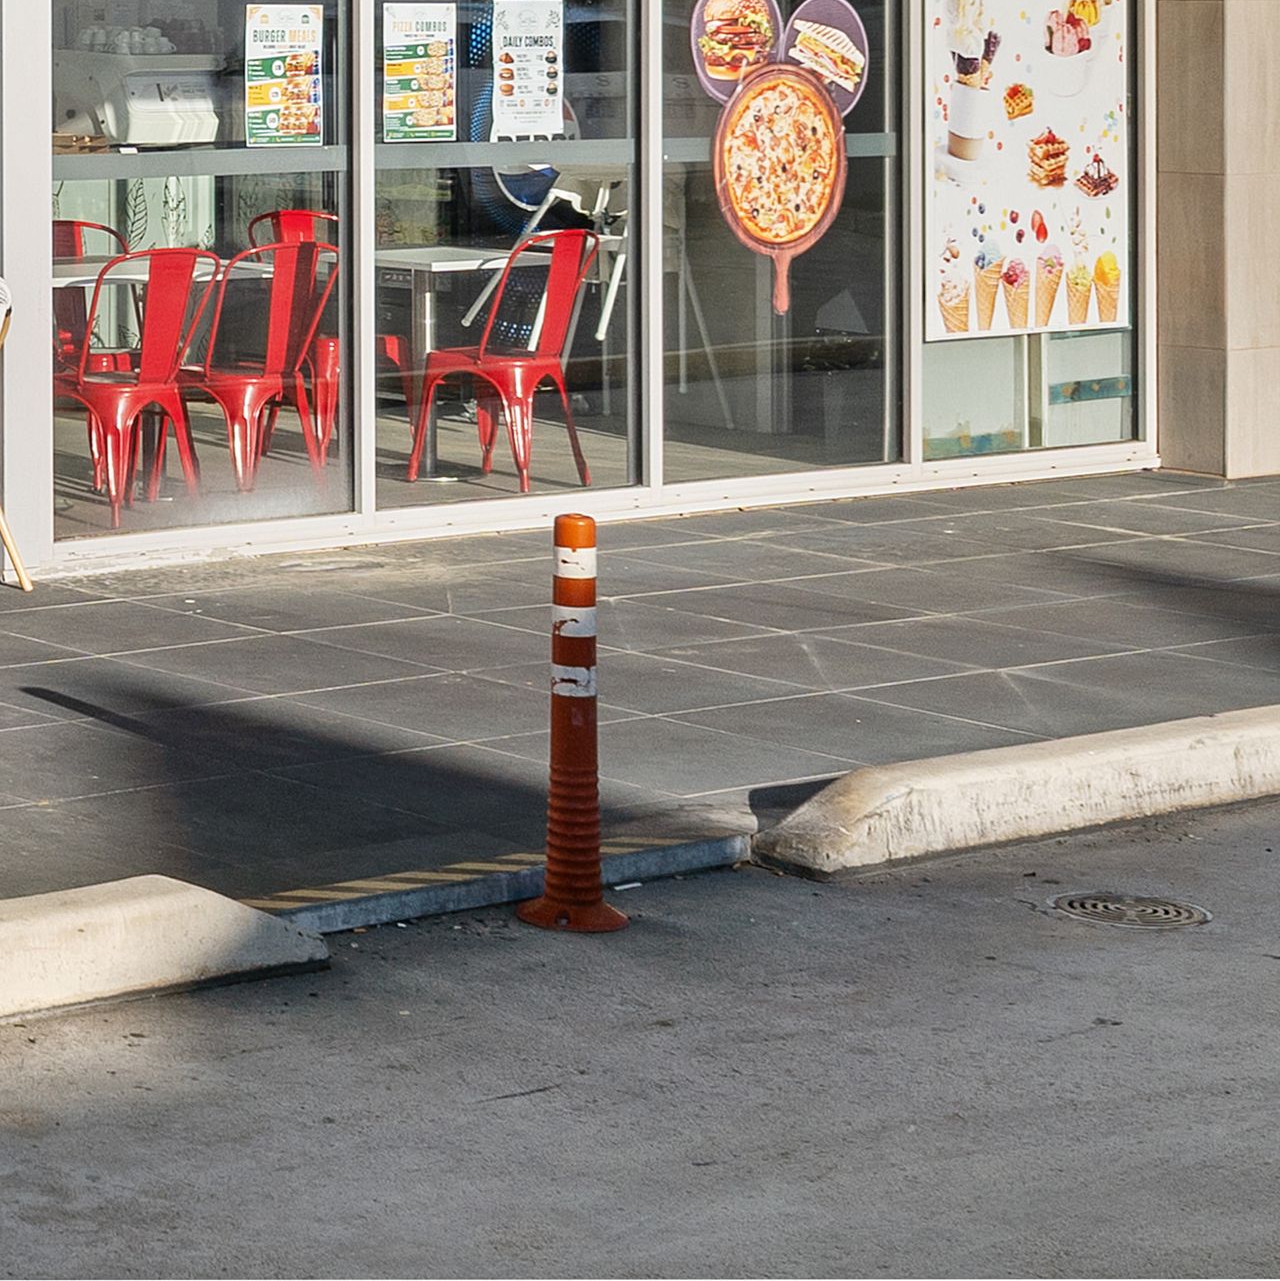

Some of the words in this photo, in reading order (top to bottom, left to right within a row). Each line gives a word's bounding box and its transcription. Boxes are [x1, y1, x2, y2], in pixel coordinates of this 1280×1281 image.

[415, 21, 447, 32] COMBOS
[253, 29, 286, 43] BURGER
[288, 29, 317, 43] MEALS
[502, 35, 522, 47] DAILY
[524, 35, 554, 47] COMBOS
